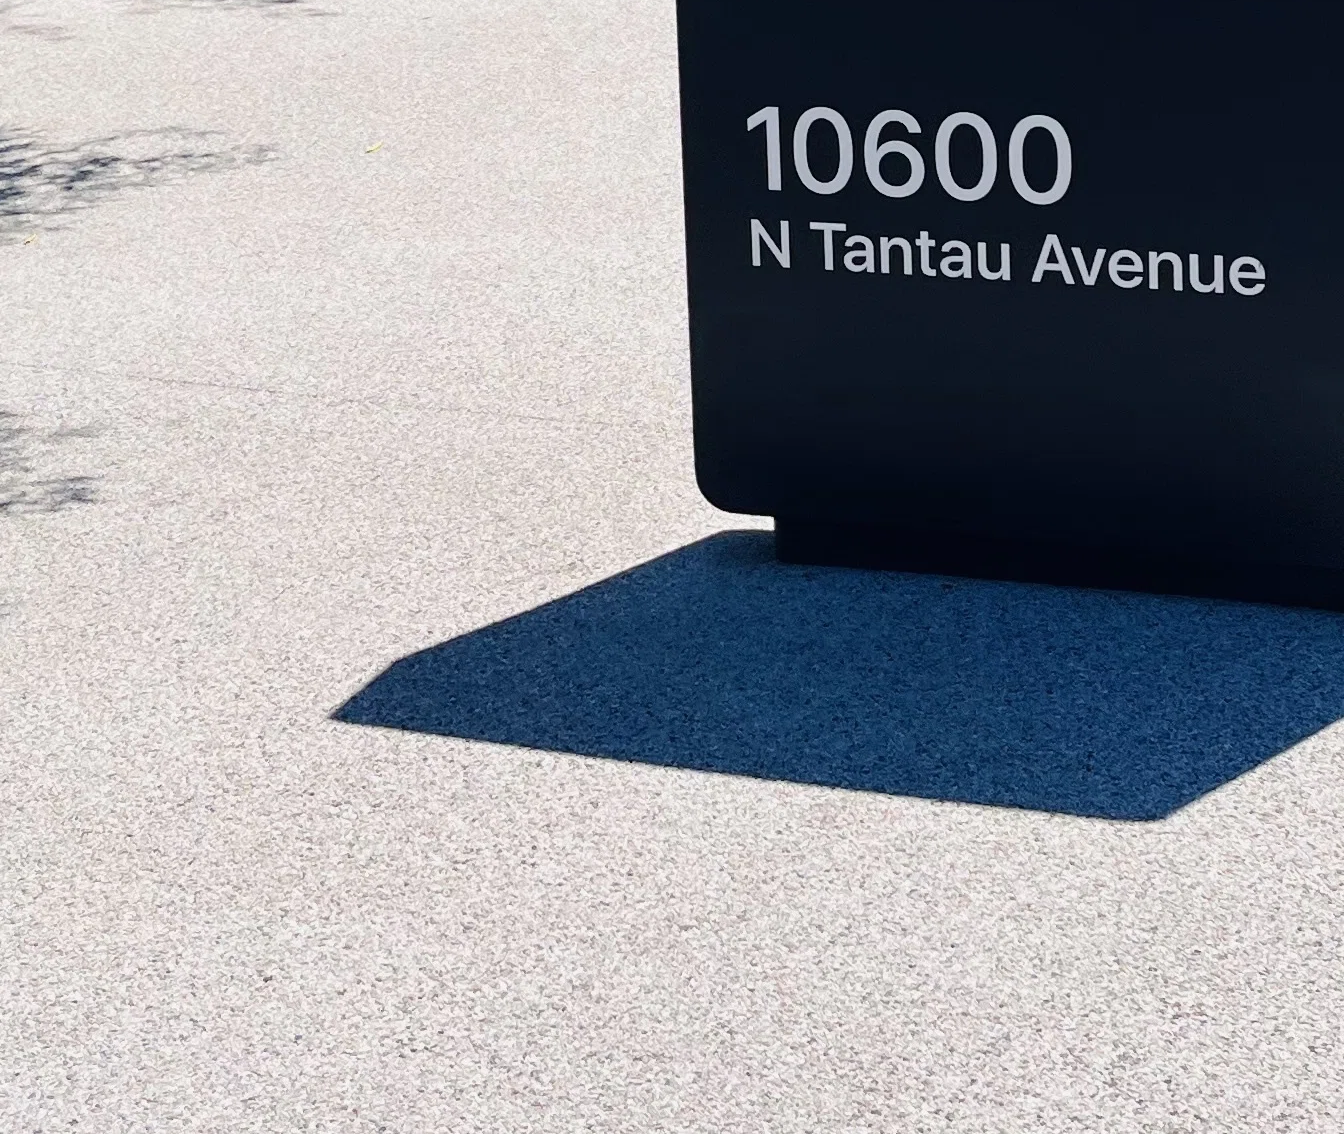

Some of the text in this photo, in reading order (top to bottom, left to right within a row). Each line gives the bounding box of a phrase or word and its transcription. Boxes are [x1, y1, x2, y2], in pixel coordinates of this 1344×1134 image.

[746, 106, 1073, 206] 10600
[750, 218, 1266, 296] N Tantau Avenue
